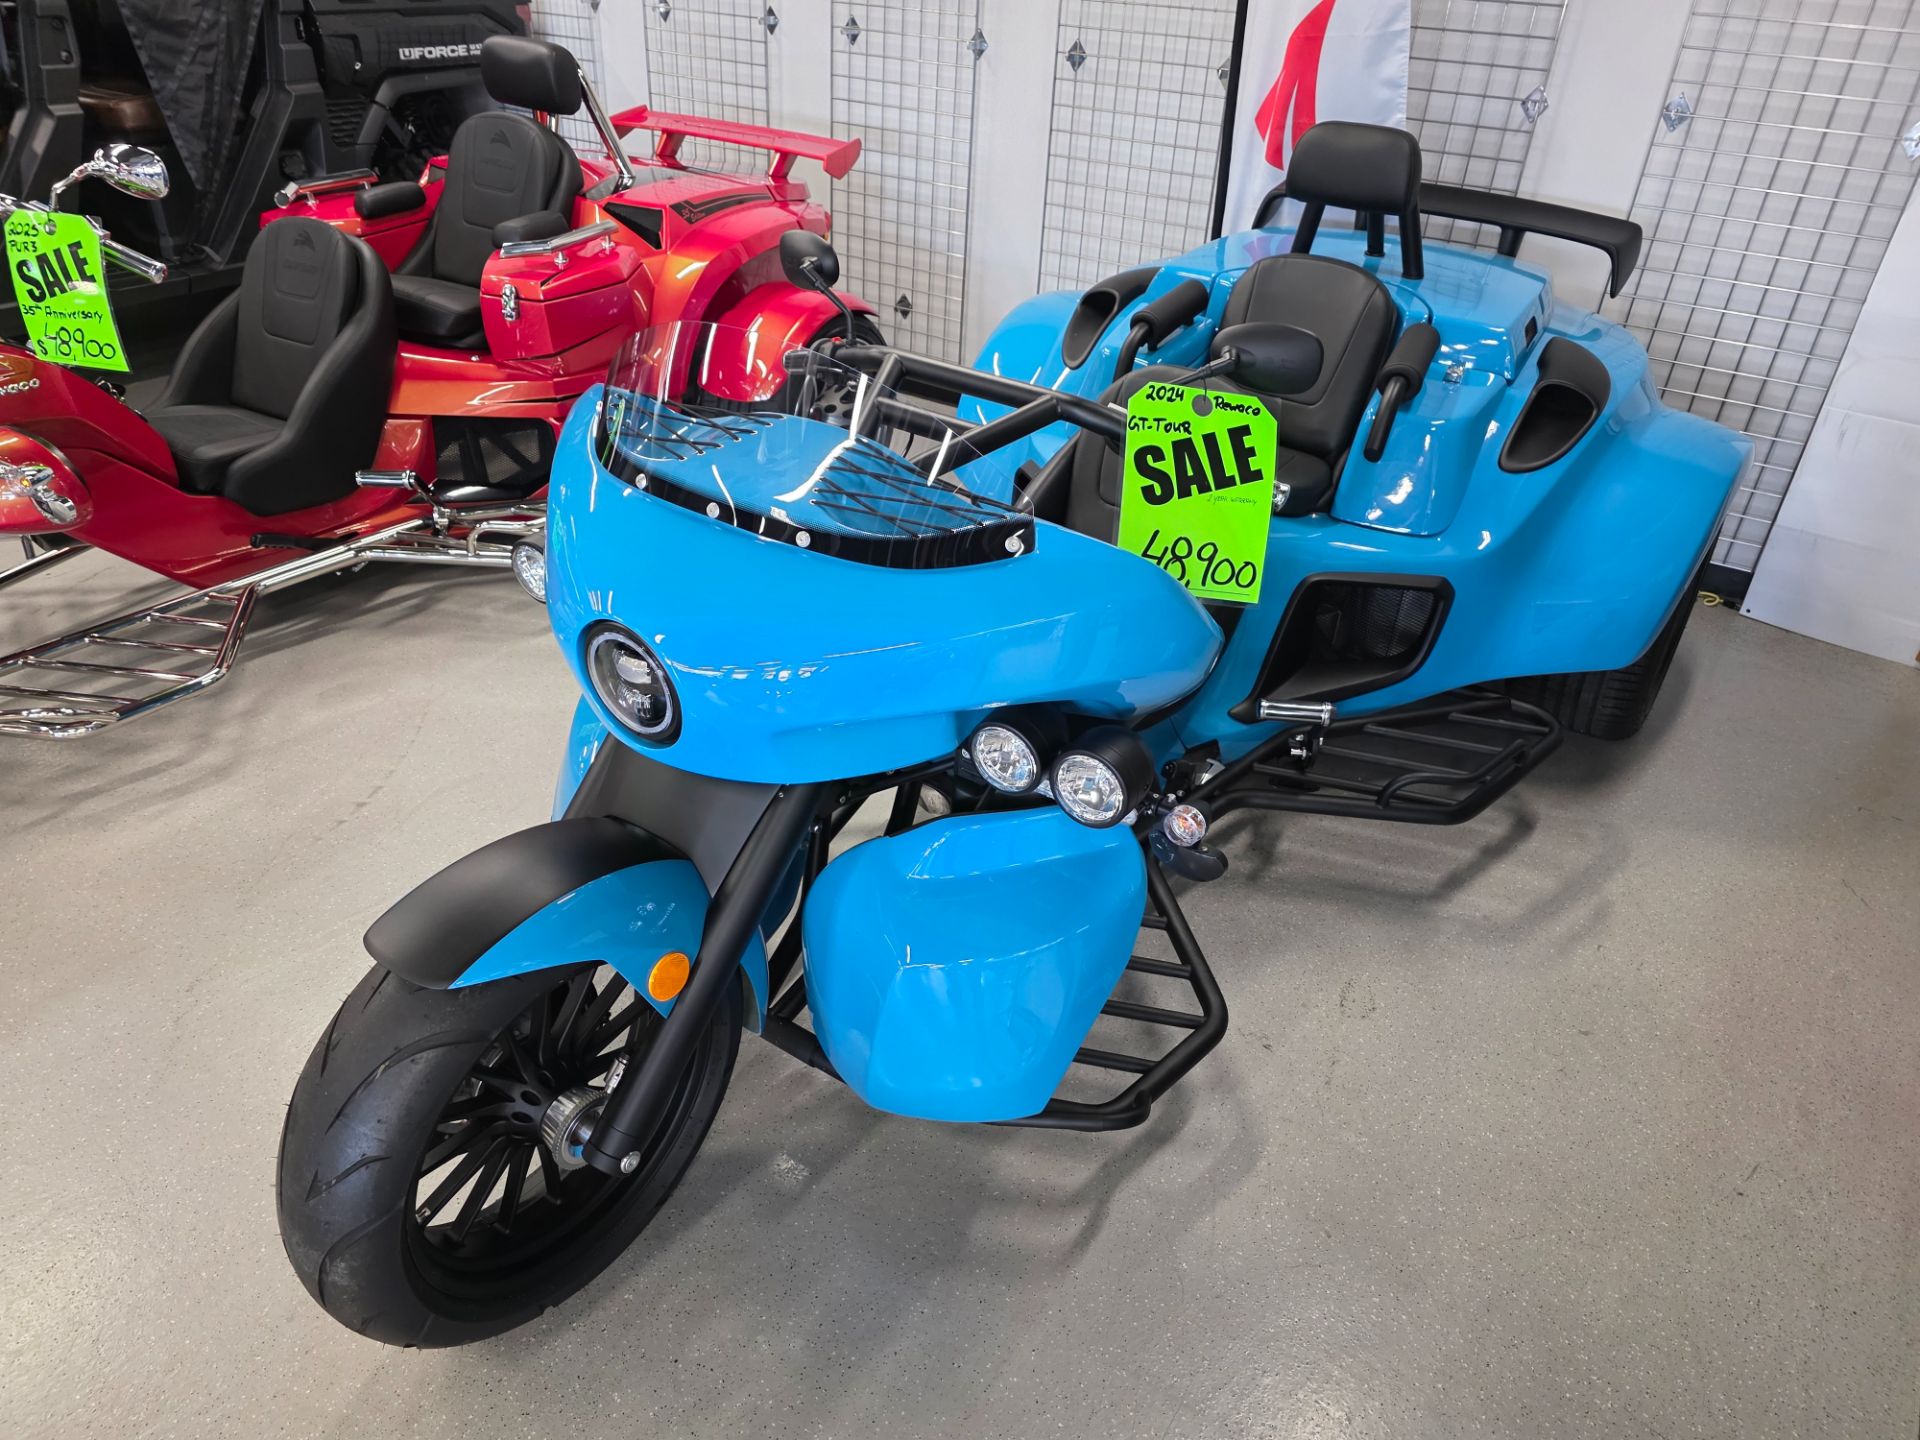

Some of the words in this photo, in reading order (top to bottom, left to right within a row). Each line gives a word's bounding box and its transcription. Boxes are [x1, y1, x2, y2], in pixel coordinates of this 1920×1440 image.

[16, 240, 96, 303] SALE
[45, 305, 103, 324] Anniversary
[1145, 385, 1185, 402] 2024
[1133, 424, 1264, 505] SALE
